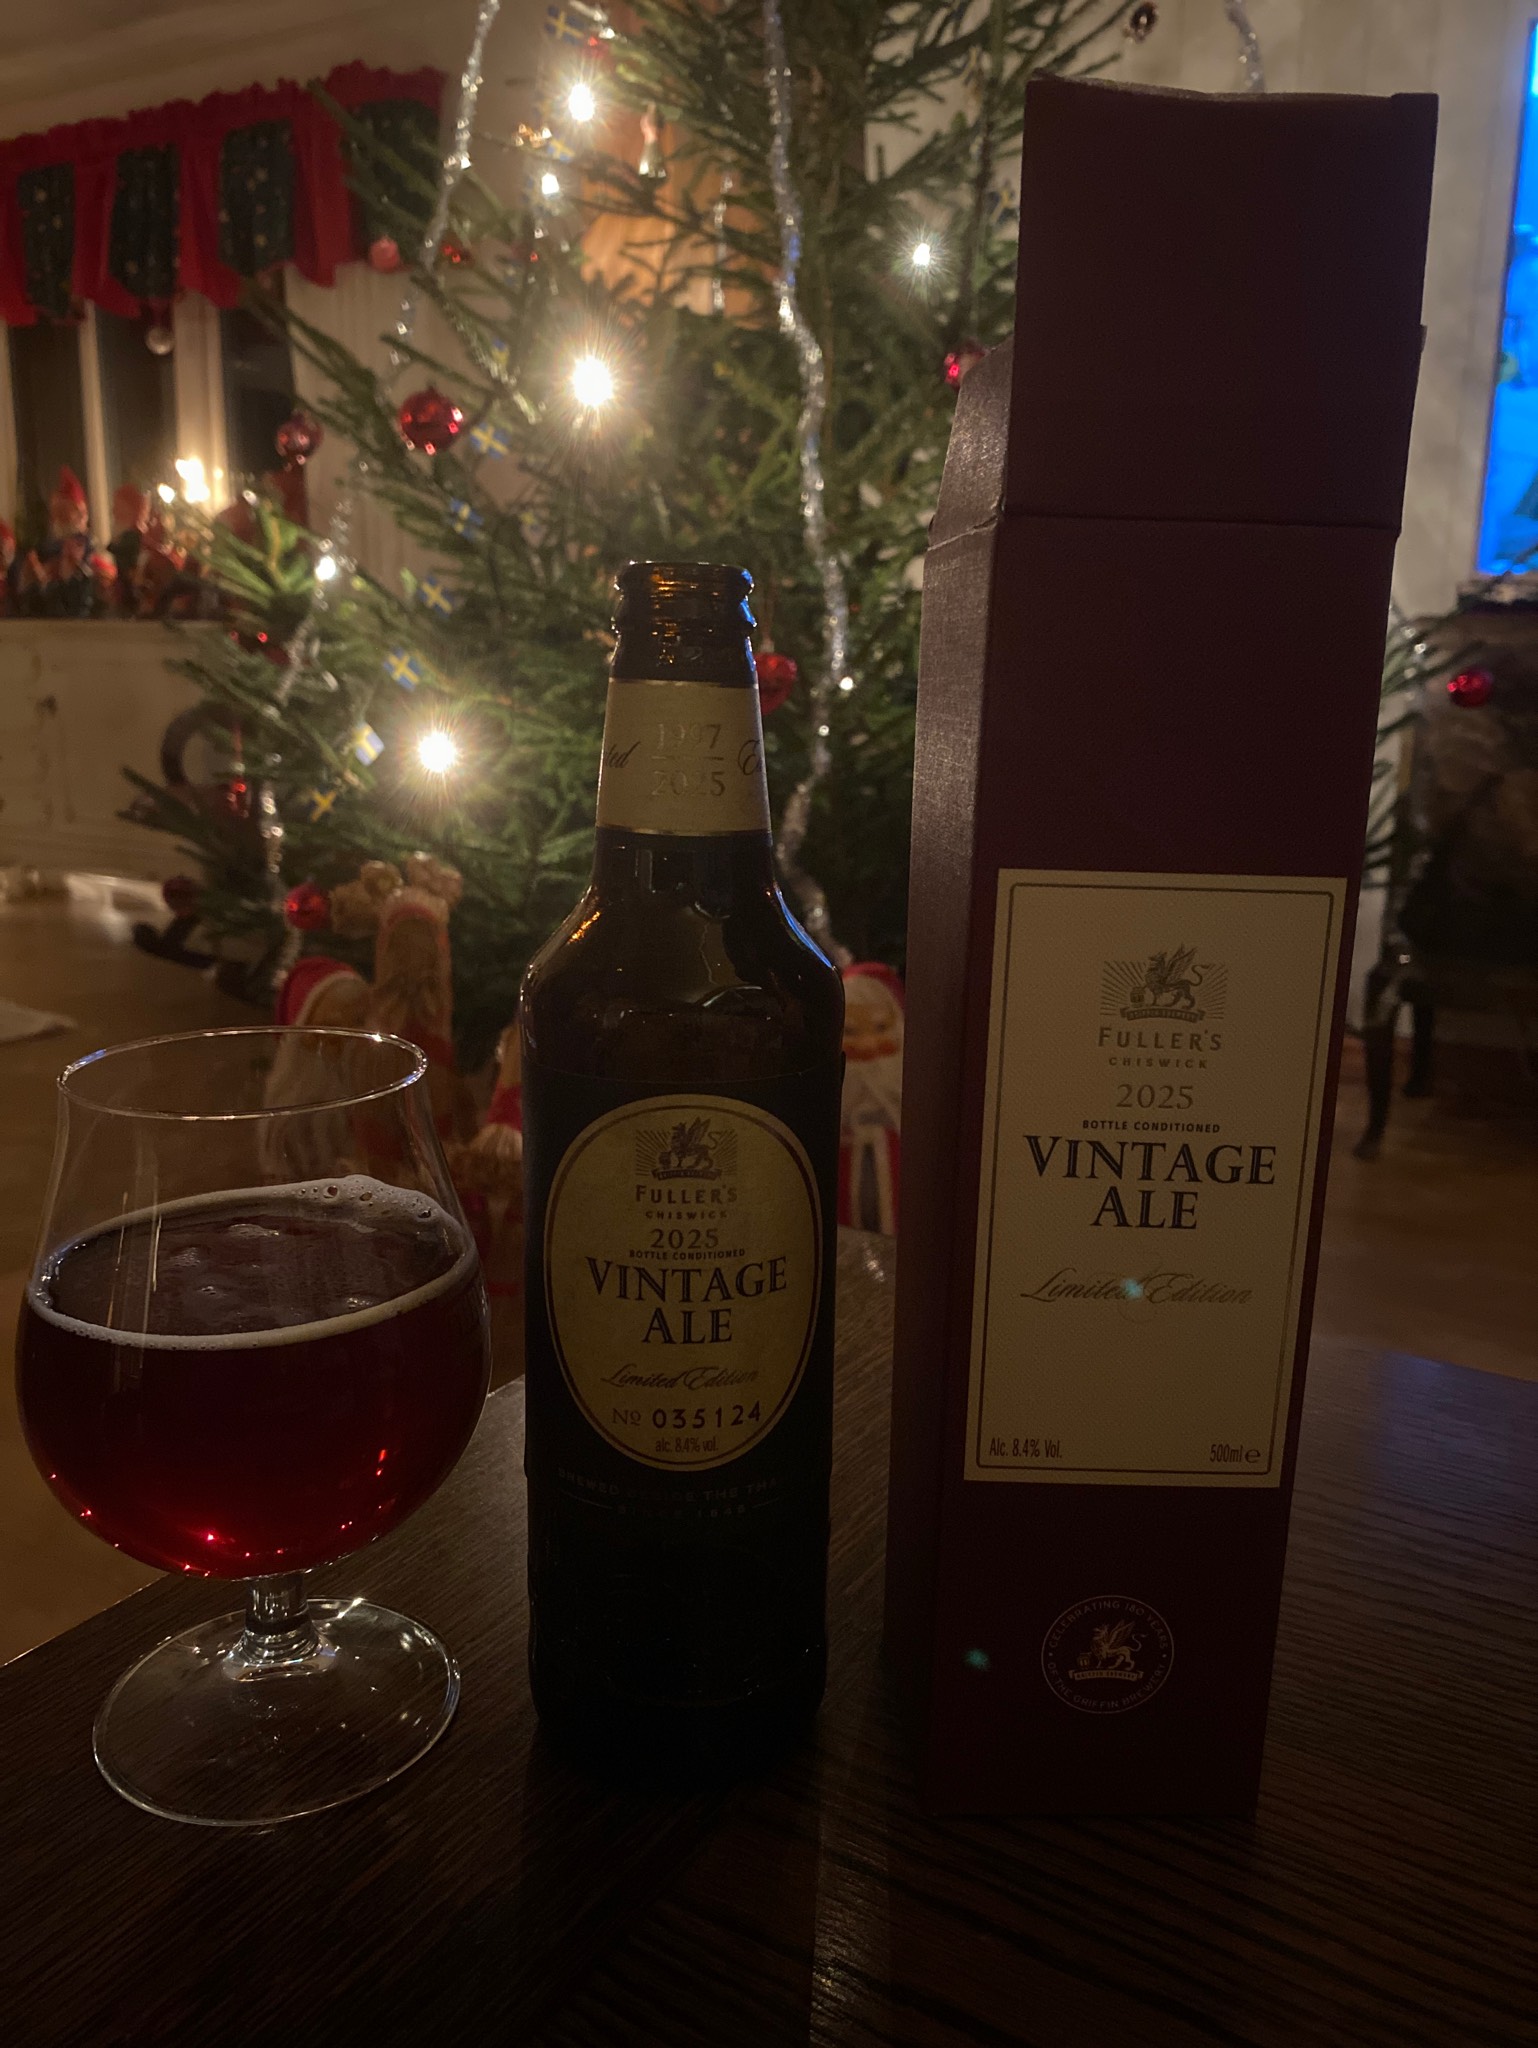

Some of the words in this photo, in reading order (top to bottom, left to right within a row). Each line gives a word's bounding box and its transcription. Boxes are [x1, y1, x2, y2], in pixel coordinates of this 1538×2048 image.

[1098, 1026, 1222, 1052] FULLER'S
[1108, 1057, 1208, 1069] CHISWICK
[1116, 1084, 1194, 1110] 2025
[1082, 1119, 1128, 1131] BOTTLE
[1134, 1121, 1221, 1134] CONDITIONED
[1023, 1135, 1277, 1185] VINTAGE
[635, 1184, 738, 1205] FULLER'S
[645, 1210, 727, 1220] CHISWICK
[1089, 1186, 1199, 1230] ALE
[650, 1228, 719, 1249] 2025
[629, 1249, 668, 1260] BOTTLE
[672, 1249, 746, 1261] CONDITIONED
[584, 1256, 787, 1303] VINTAGE
[1144, 1273, 1252, 1304] Edition
[641, 1307, 733, 1345] ALE
[601, 1363, 686, 1389] Limited
[683, 1366, 759, 1391] Edition
[652, 1401, 761, 1429] 035124
[989, 1437, 1009, 1457] Alc.
[1012, 1438, 1041, 1458] 8.4%
[1044, 1439, 1063, 1459] Vol.
[1209, 1443, 1243, 1463] 500ml
[702, 1485, 739, 1502] THE
[1048, 1599, 1121, 1649] CELEBRATING
[1146, 1613, 1169, 1650] YEARS
[1047, 1661, 1060, 1677] OF
[1053, 1677, 1074, 1698] THE
[1121, 1663, 1166, 1707] BREWERY
[1072, 1694, 1120, 1710] GRIFFIN
